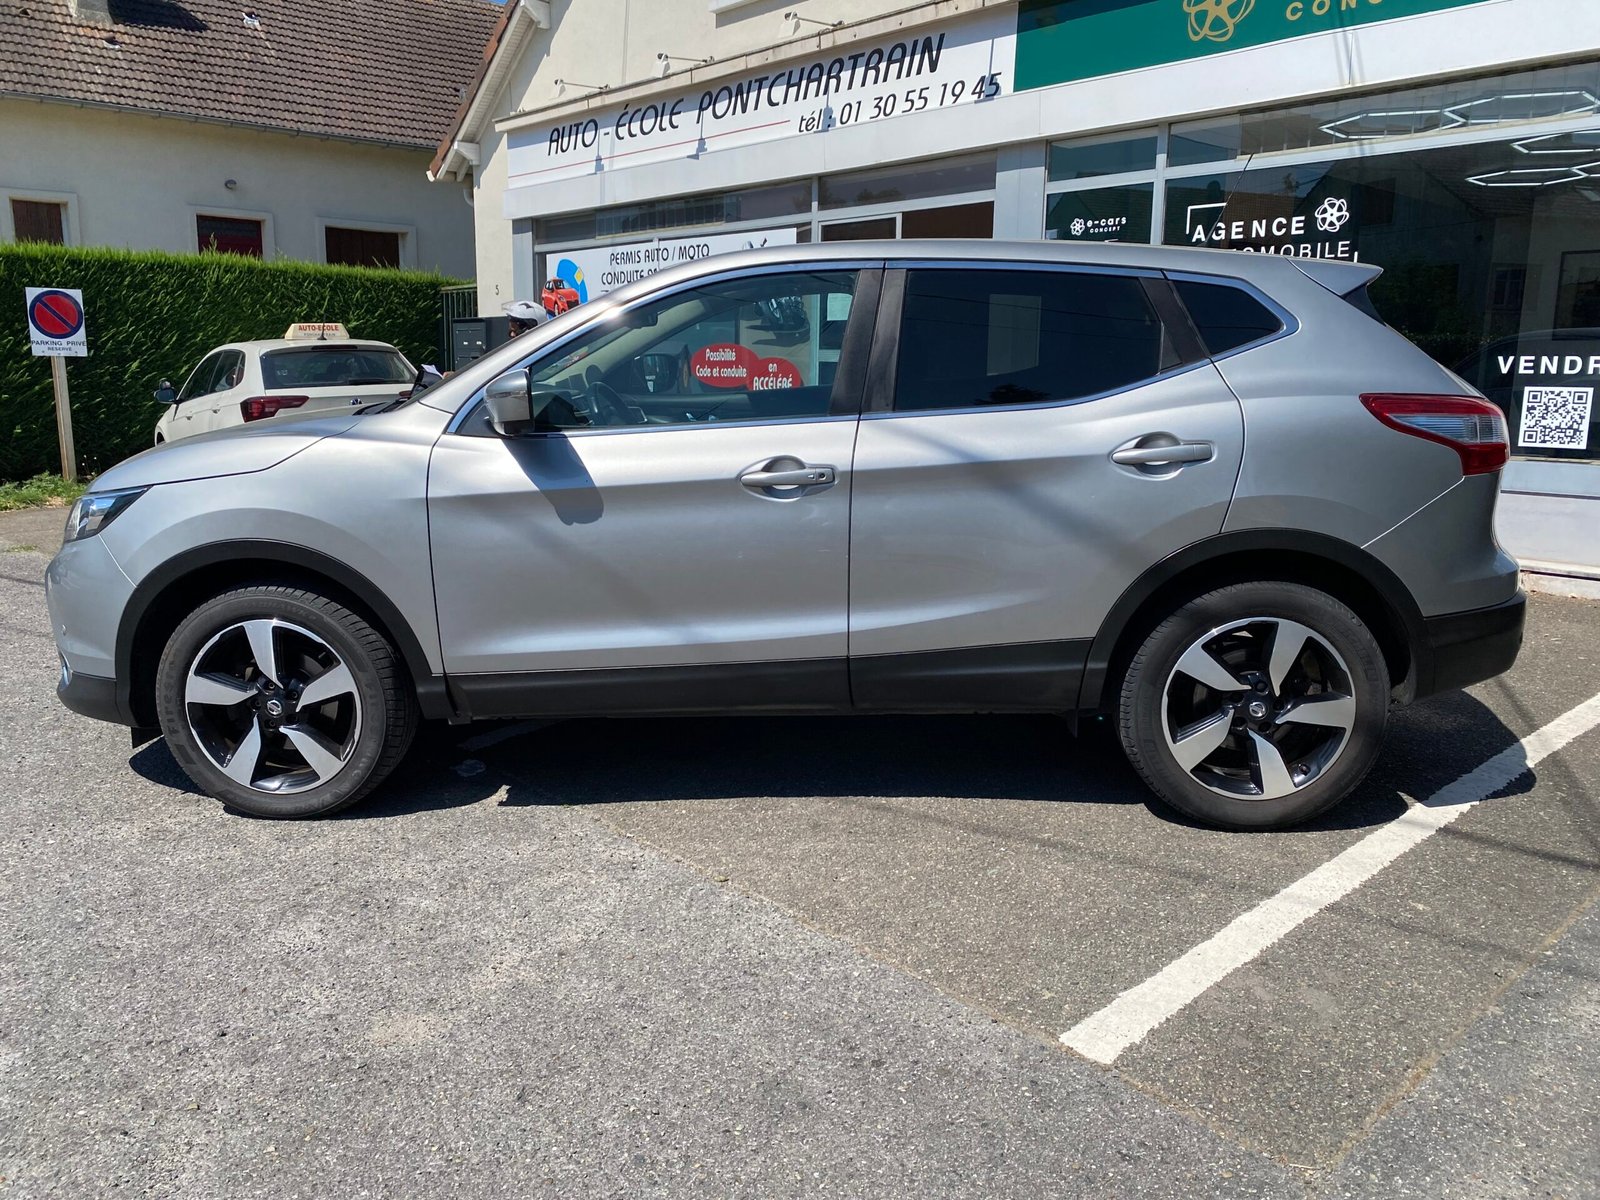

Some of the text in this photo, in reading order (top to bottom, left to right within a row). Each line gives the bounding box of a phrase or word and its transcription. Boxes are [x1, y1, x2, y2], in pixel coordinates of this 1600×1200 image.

[1285, 0, 1381, 21] CON
[547, 118, 599, 156] AUTO
[614, 98, 684, 141] ÉCOLE
[696, 32, 946, 124] PONTCHARTRAIN
[798, 108, 823, 133] tél
[839, 100, 862, 126] 01
[869, 93, 897, 120] 30
[901, 87, 930, 114] 55
[939, 80, 966, 107] 19
[970, 72, 1002, 99] 45
[1086, 216, 1127, 228] e-cars
[1089, 225, 1121, 234] CONCEPT
[1191, 216, 1306, 243] AGENCE
[609, 250, 641, 266] PERMIS
[644, 247, 669, 263] AUTO
[678, 243, 710, 260] MOTO
[1232, 240, 1351, 259] OBILE
[601, 269, 644, 286] CONDUITE
[495, 284, 500, 296] 5
[705, 348, 737, 361] Possibilité
[695, 364, 747, 378] Code et conduite
[768, 363, 778, 372] en
